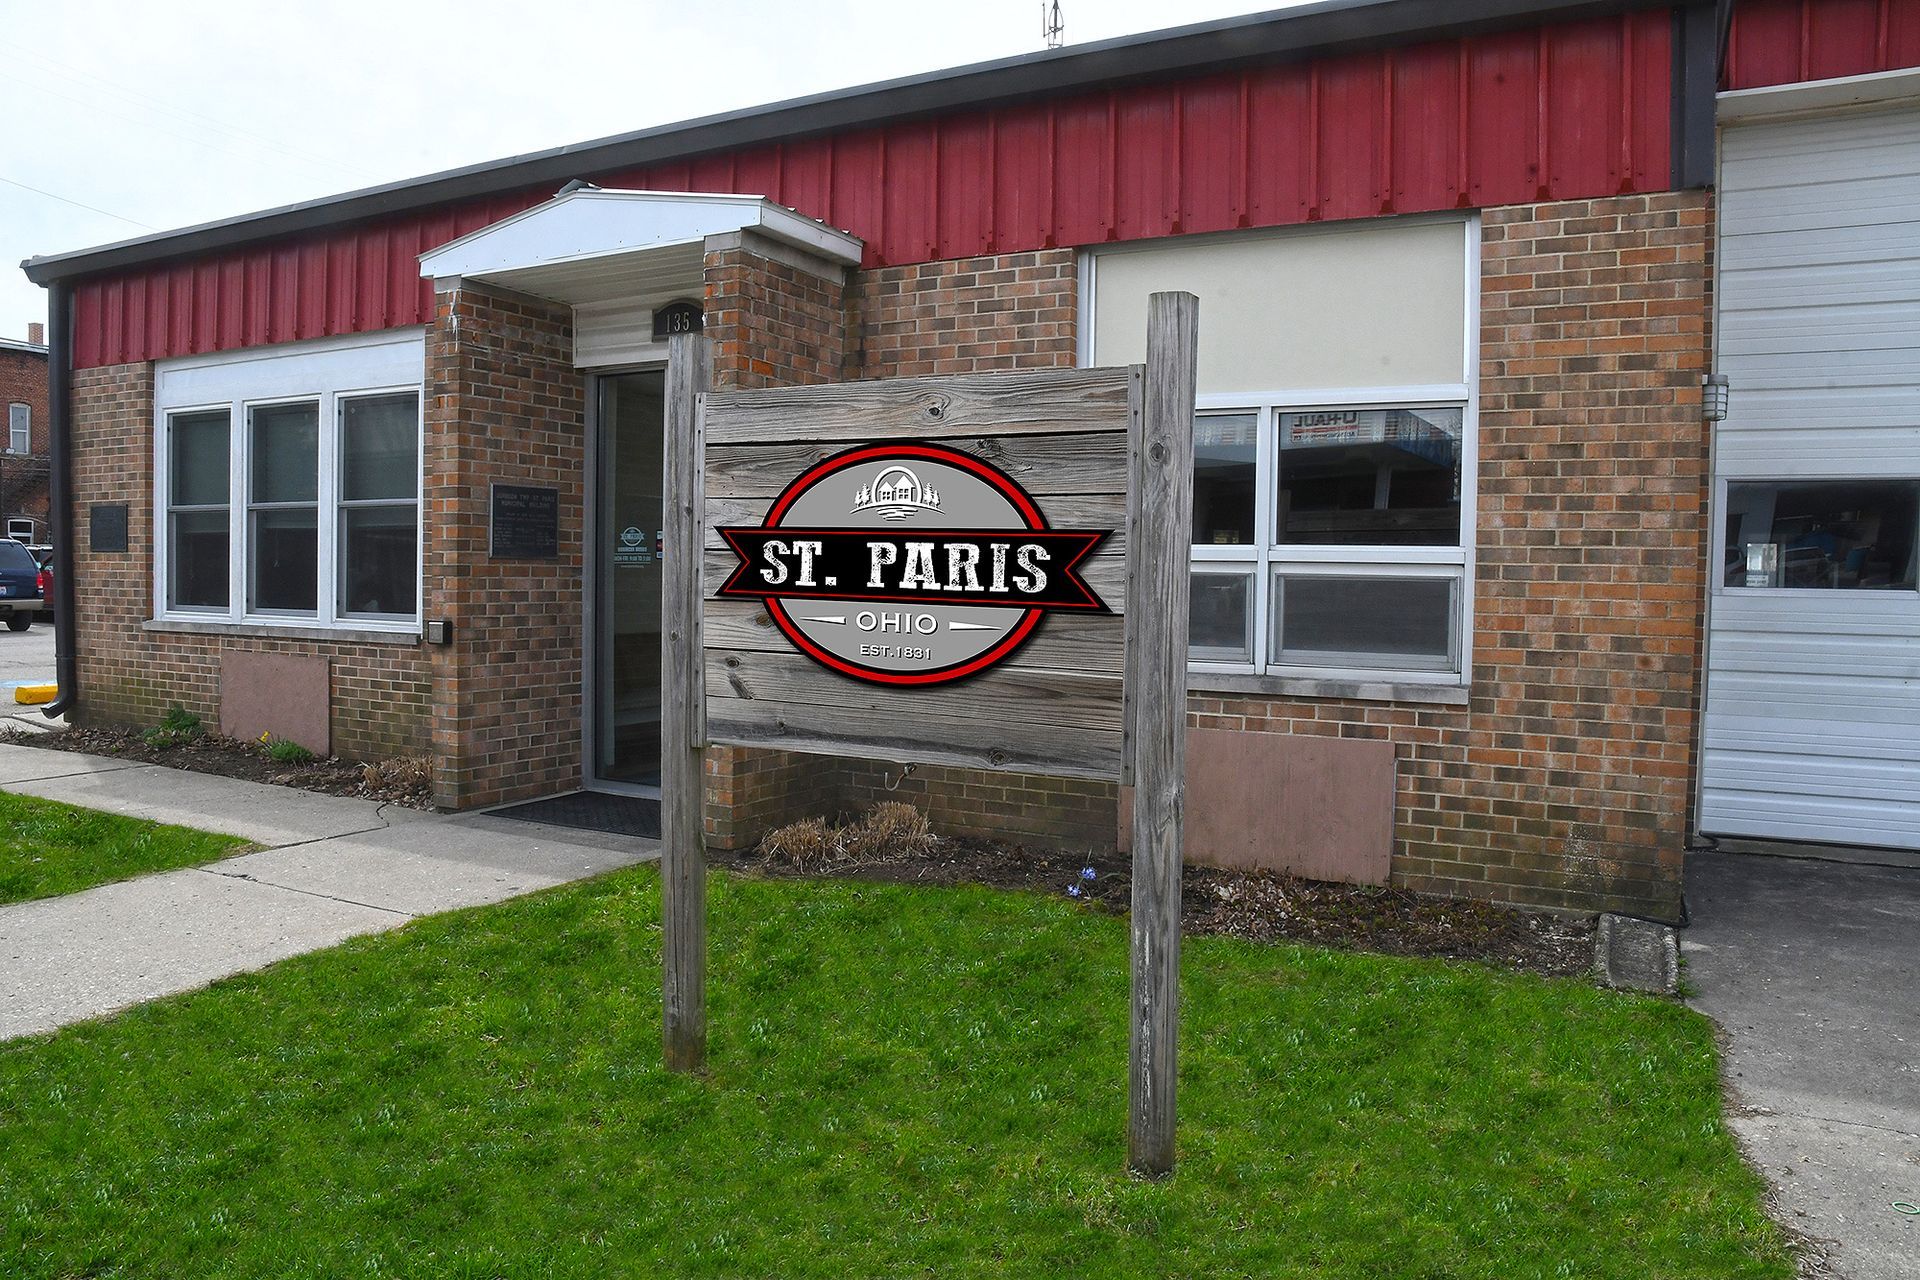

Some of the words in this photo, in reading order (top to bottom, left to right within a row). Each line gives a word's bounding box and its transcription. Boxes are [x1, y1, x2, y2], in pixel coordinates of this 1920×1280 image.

[666, 312, 690, 332] 135
[760, 540, 837, 587] ST.
[866, 542, 1051, 593] PARIS
[856, 611, 938, 635] OHIO
